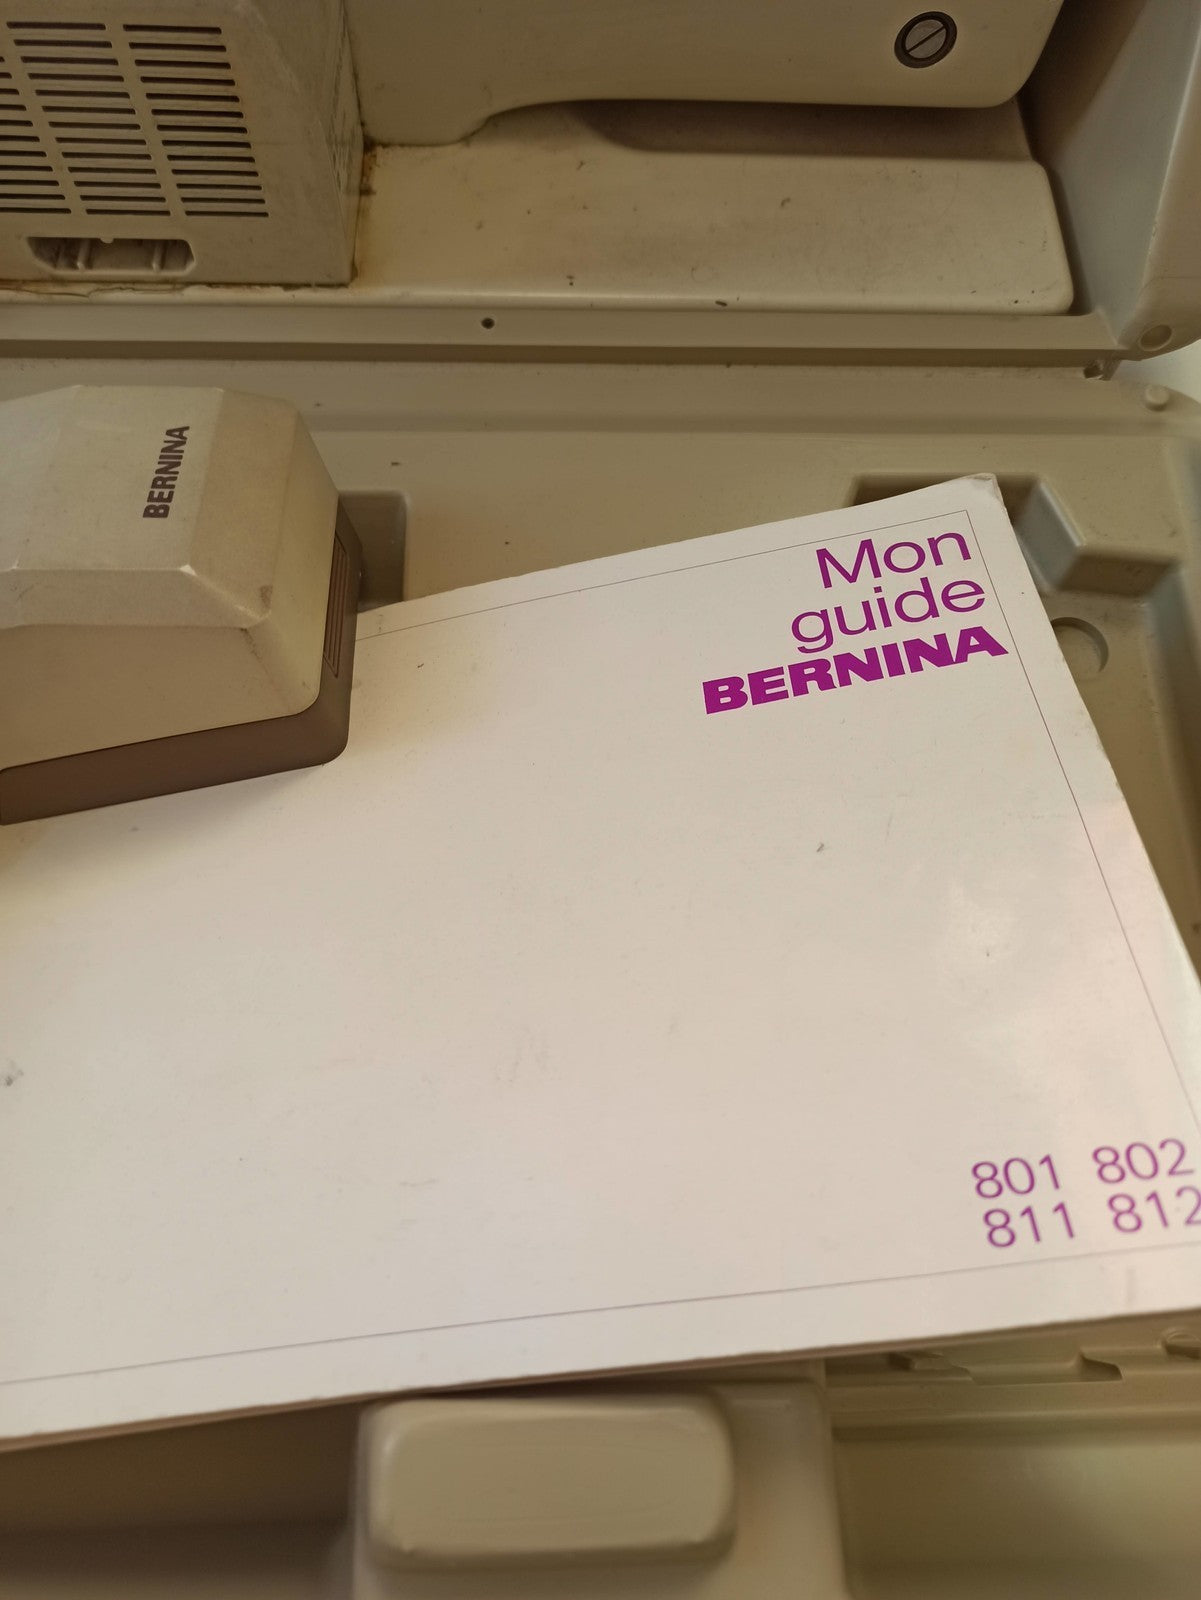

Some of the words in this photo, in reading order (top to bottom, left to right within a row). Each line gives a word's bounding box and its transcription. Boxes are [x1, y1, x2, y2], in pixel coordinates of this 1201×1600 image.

[142, 426, 190, 519] BERNINA
[815, 532, 971, 590] Mon
[791, 576, 985, 655] guide
[701, 625, 1008, 715] BERNINA
[971, 1154, 1060, 1199] 801
[1092, 1138, 1195, 1184] 802
[983, 1202, 1075, 1248] 811
[1107, 1186, 1201, 1233] 812
